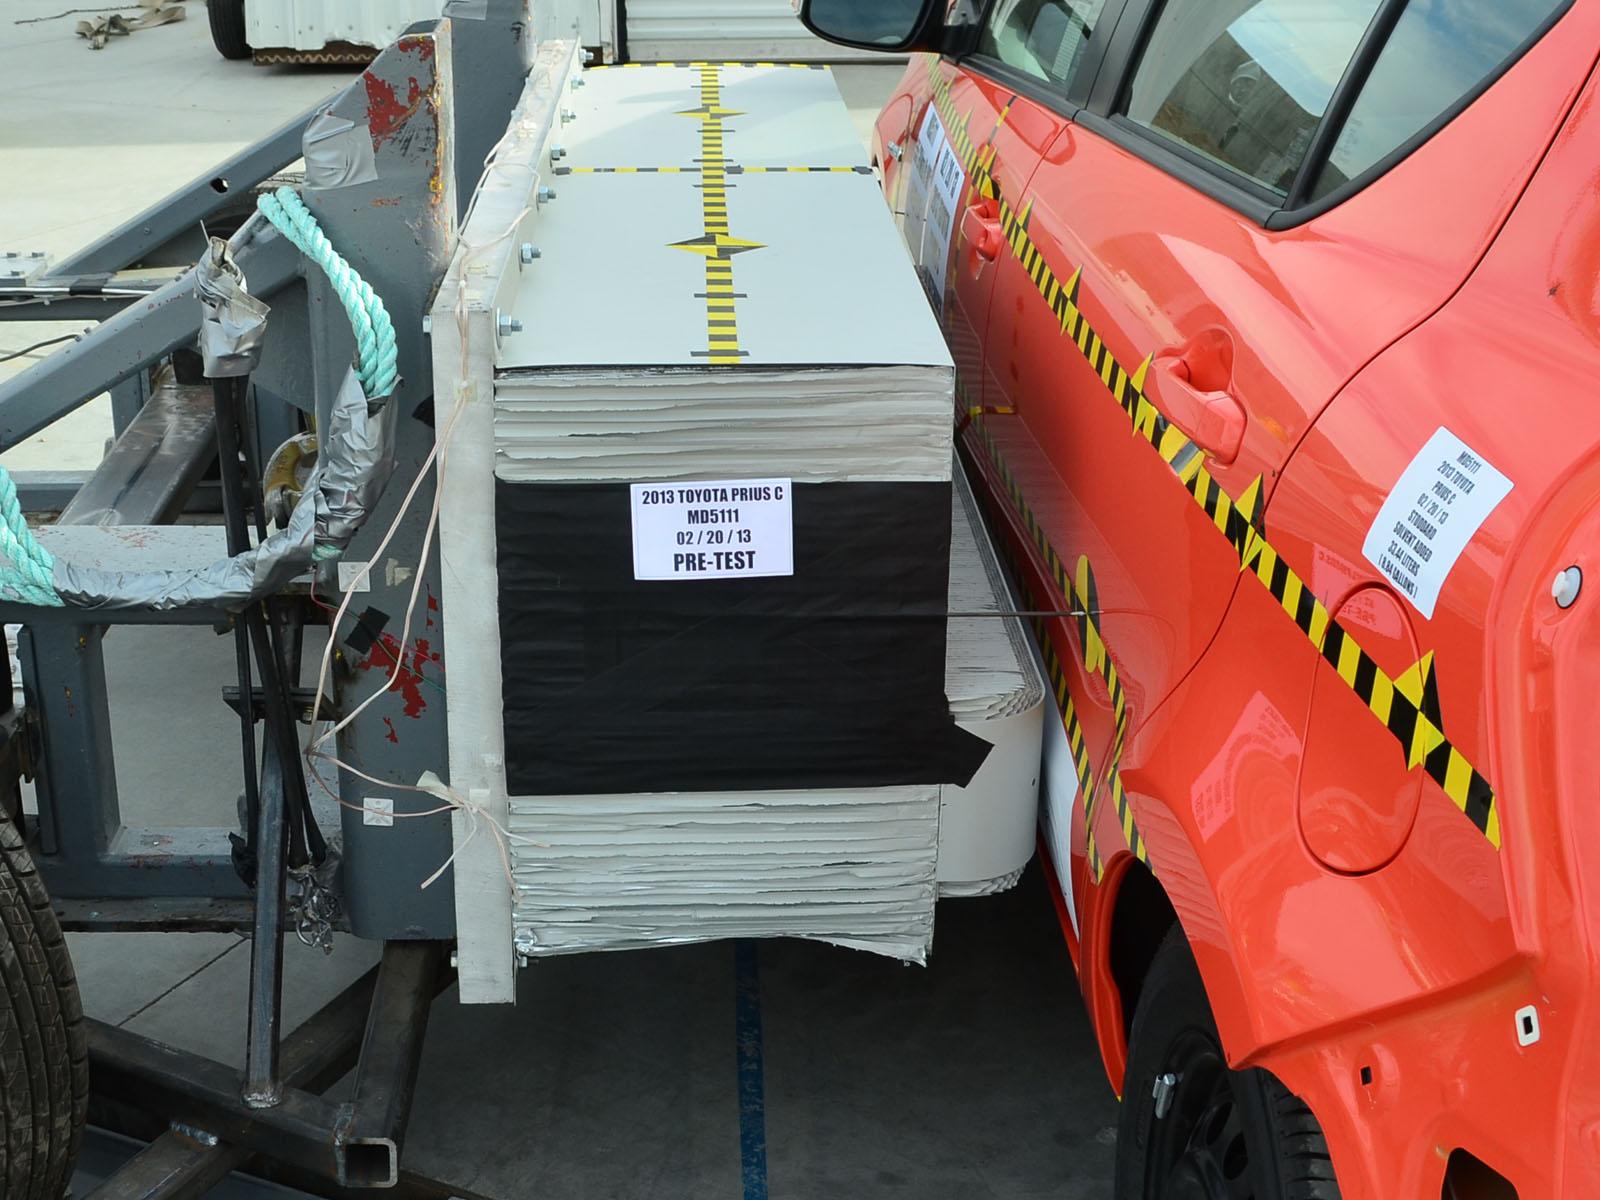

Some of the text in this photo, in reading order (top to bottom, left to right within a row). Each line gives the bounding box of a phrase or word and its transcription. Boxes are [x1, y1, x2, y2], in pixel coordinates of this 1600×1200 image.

[1456, 450, 1482, 474] MD5111
[1437, 460, 1475, 495] 2013 TOYOTA
[642, 486, 783, 504] 2013 TOYOTA PRIUS C
[1417, 493, 1429, 507] 02
[1427, 502, 1439, 516] 20
[1431, 480, 1457, 505] PRIUS C
[687, 508, 739, 525] MD5111
[1407, 509, 1437, 540] STODDARD
[676, 531, 693, 545] 02
[706, 530, 724, 544] 20
[737, 528, 751, 543] 13
[1393, 520, 1433, 562] SOLVENT ADDED
[673, 550, 756, 572] PRE-TEST
[1401, 553, 1420, 577] LITERS
[1392, 566, 1415, 595] GALLONS
